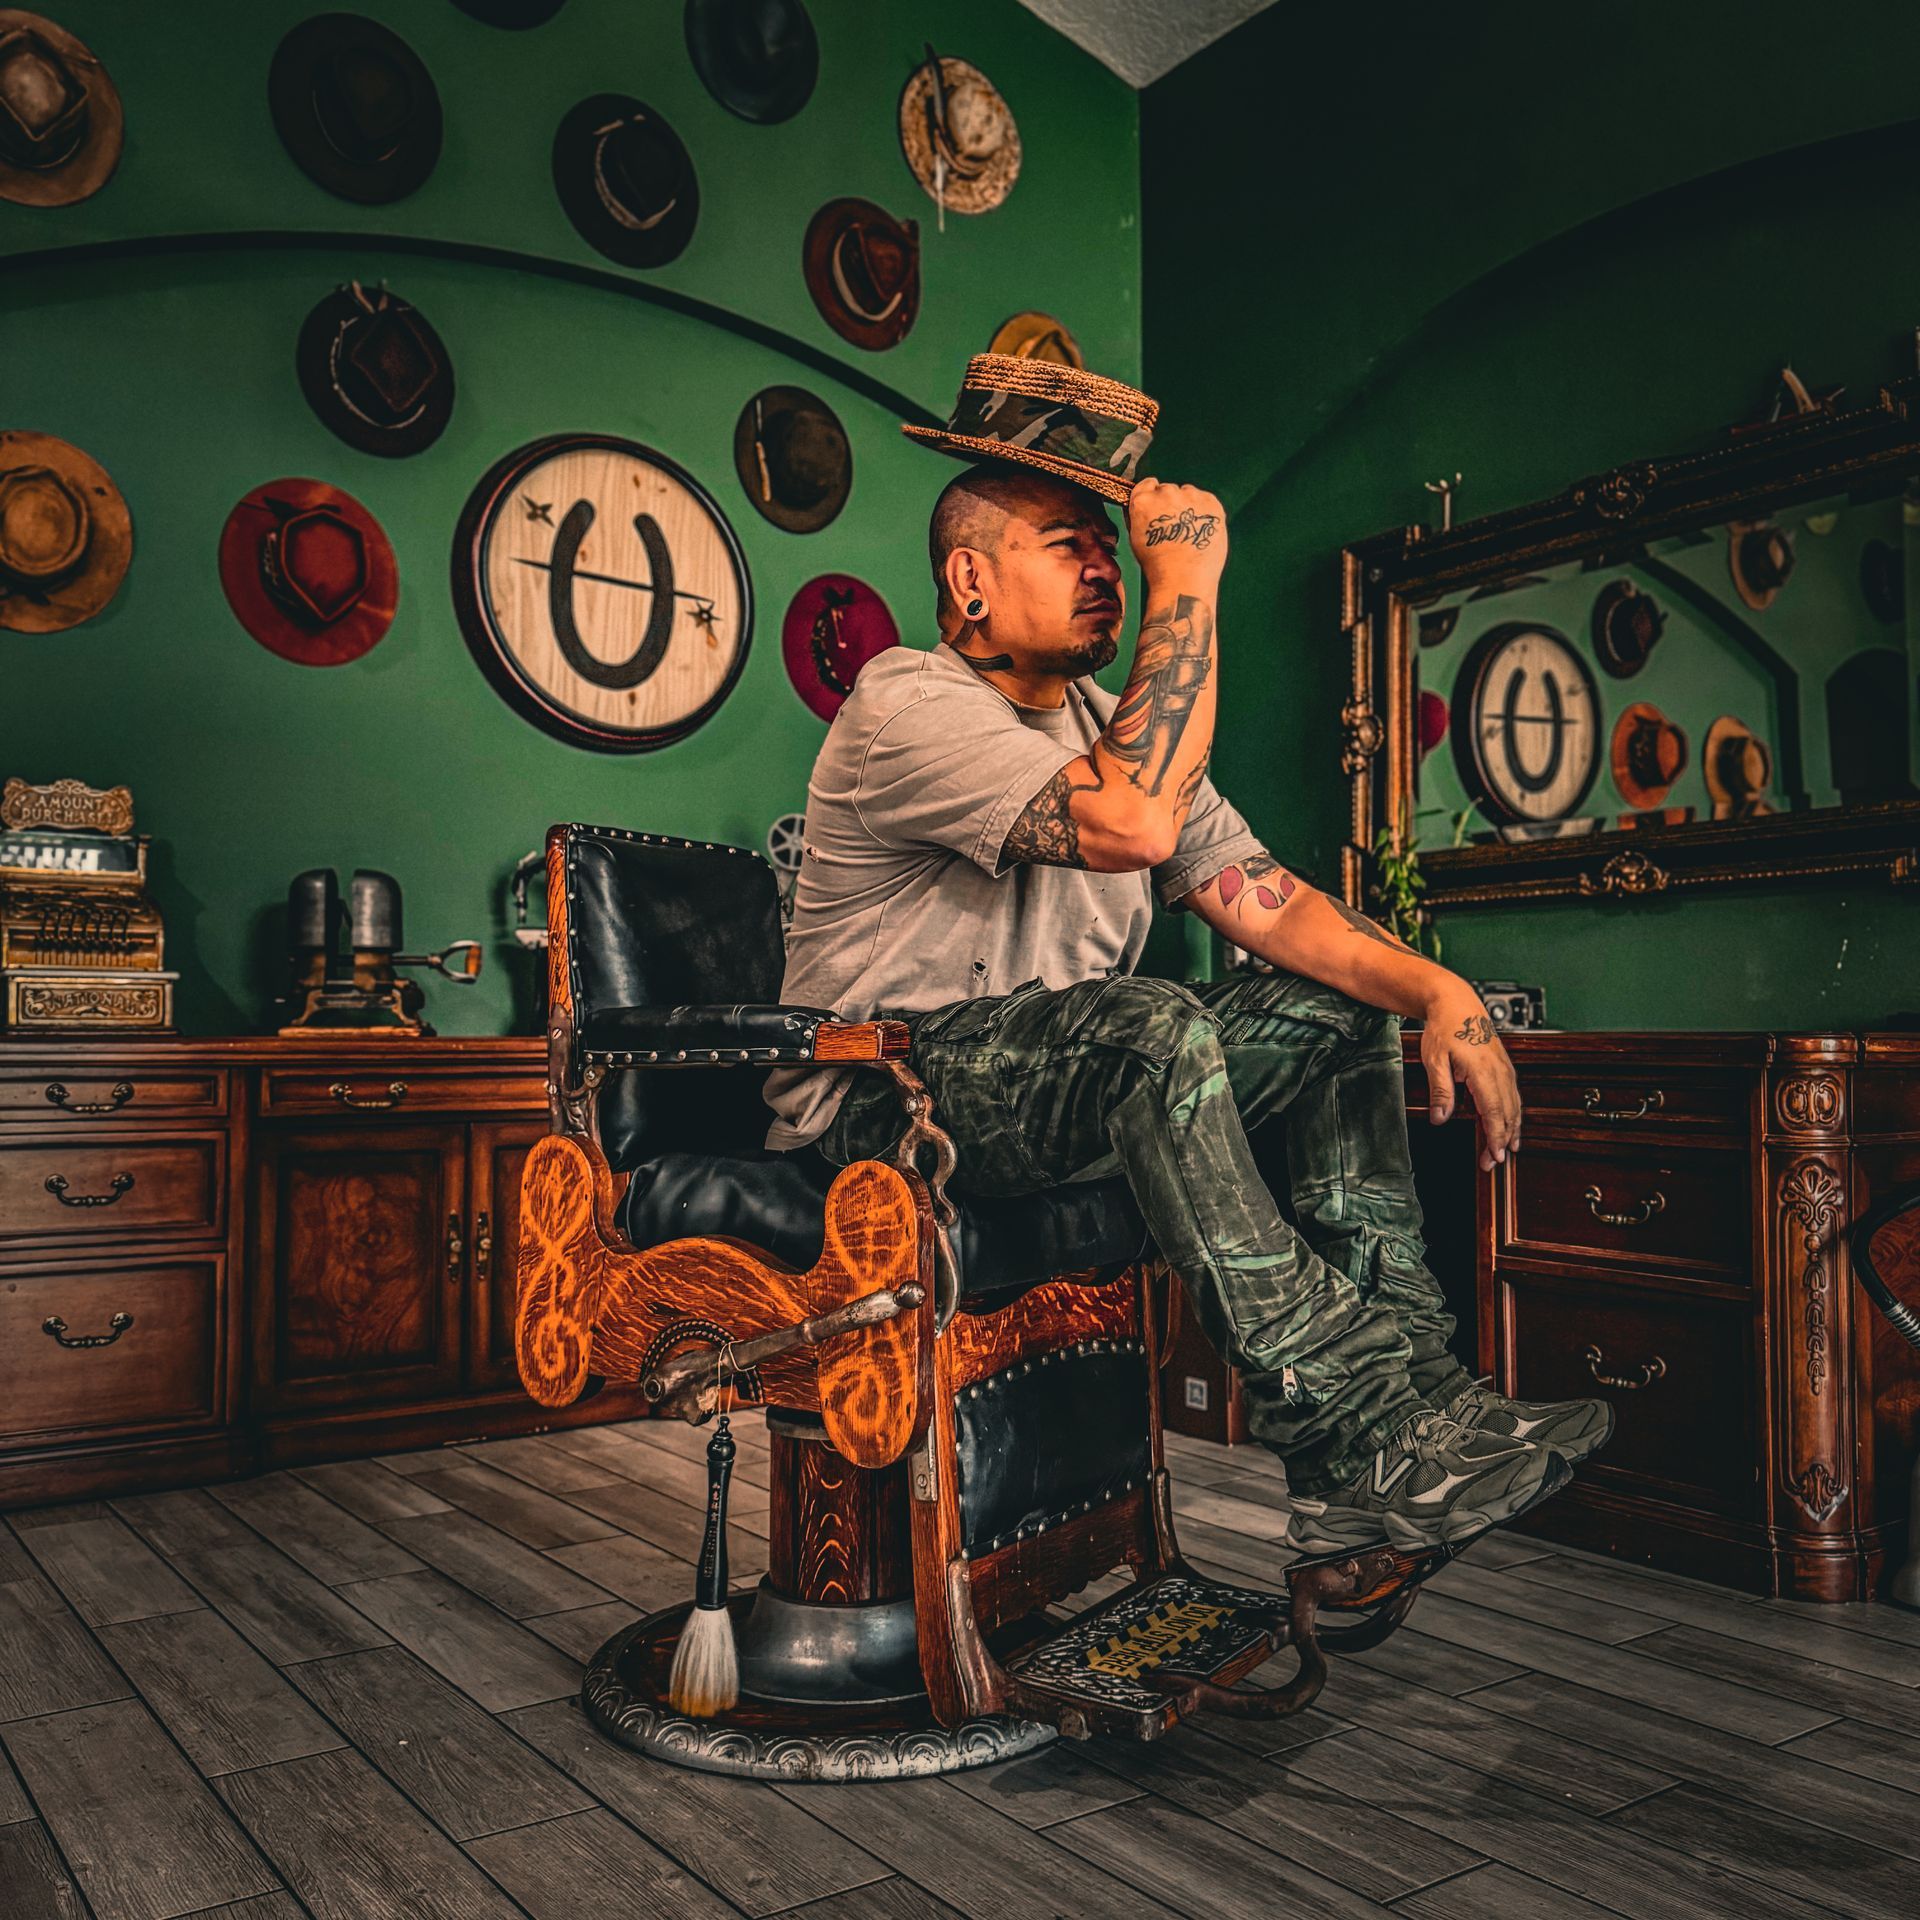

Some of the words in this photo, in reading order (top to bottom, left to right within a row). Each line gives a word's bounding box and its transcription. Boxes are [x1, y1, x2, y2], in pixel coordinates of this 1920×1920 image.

[35, 795, 103, 811] AMOUNT
[48, 990, 135, 1015] NATIONAL
[1181, 1606, 1216, 1619] DO
[1159, 1615, 1201, 1634] NOT
[1132, 1630, 1178, 1651] STEP
[1096, 1647, 1150, 1672] HERE
